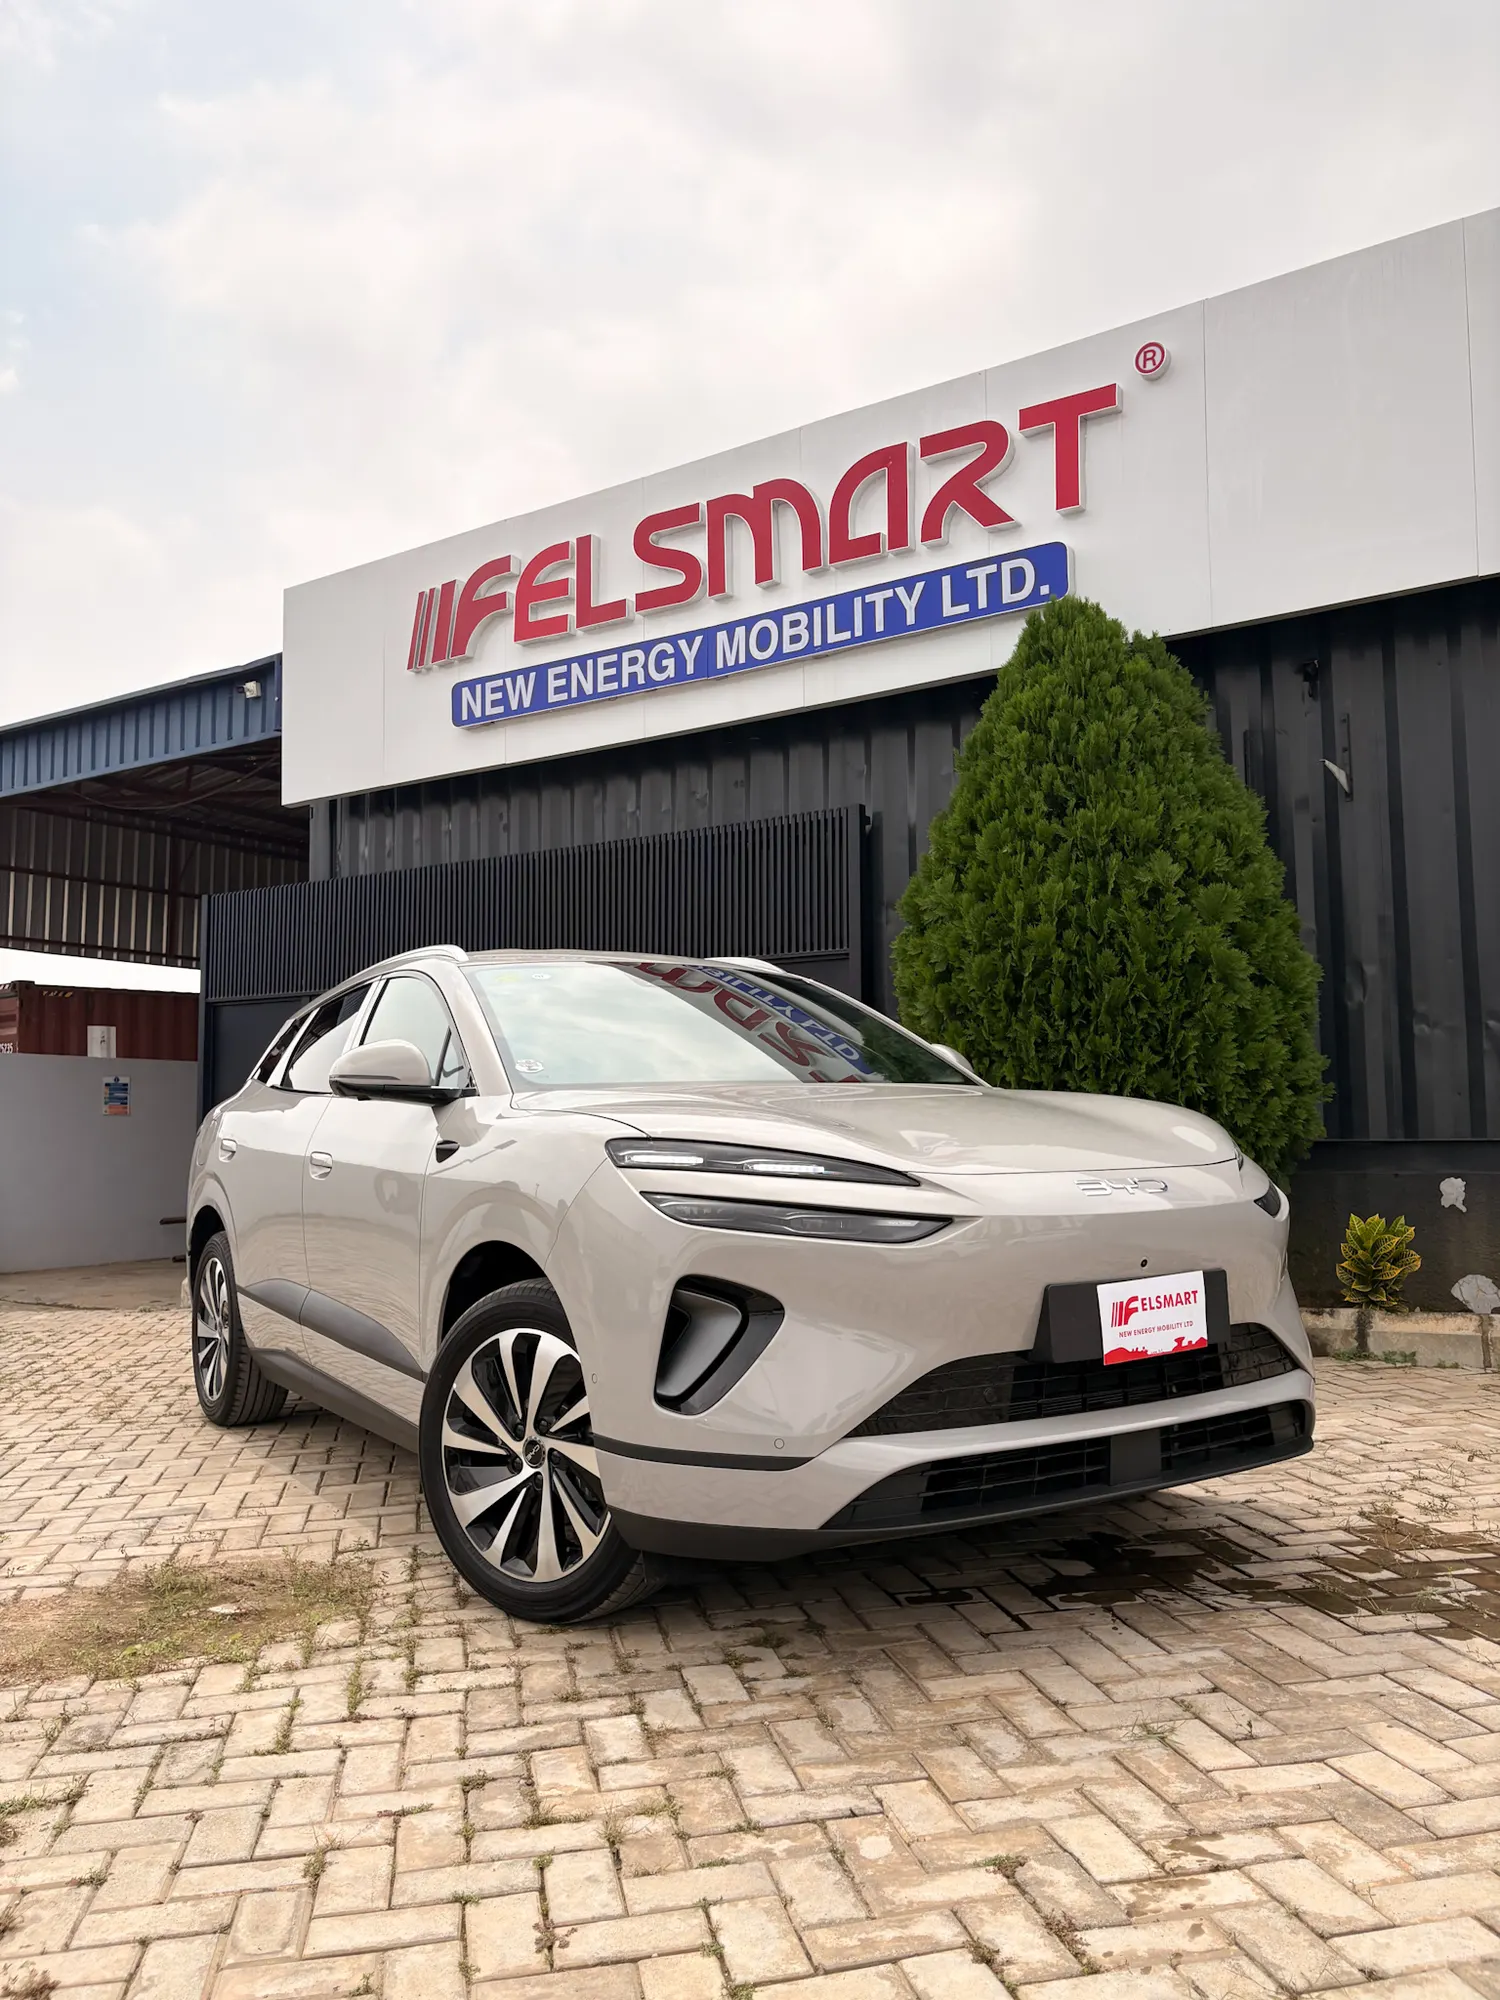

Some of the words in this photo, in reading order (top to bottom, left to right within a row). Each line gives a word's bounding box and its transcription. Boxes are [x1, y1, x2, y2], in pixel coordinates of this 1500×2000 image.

[446, 382, 1120, 660] FELSMART
[460, 671, 537, 722] NEW
[547, 635, 704, 704] ENERGY
[715, 580, 927, 670] MOBILITY
[941, 557, 1050, 618] LTD.
[1073, 1177, 1168, 1197] BYD
[1123, 1290, 1198, 1326] FELSMART
[1119, 1330, 1132, 1338] NEW
[1133, 1326, 1156, 1336] ENERGY
[1156, 1322, 1183, 1332] MOBILITY
[1183, 1320, 1194, 1328] LTD
